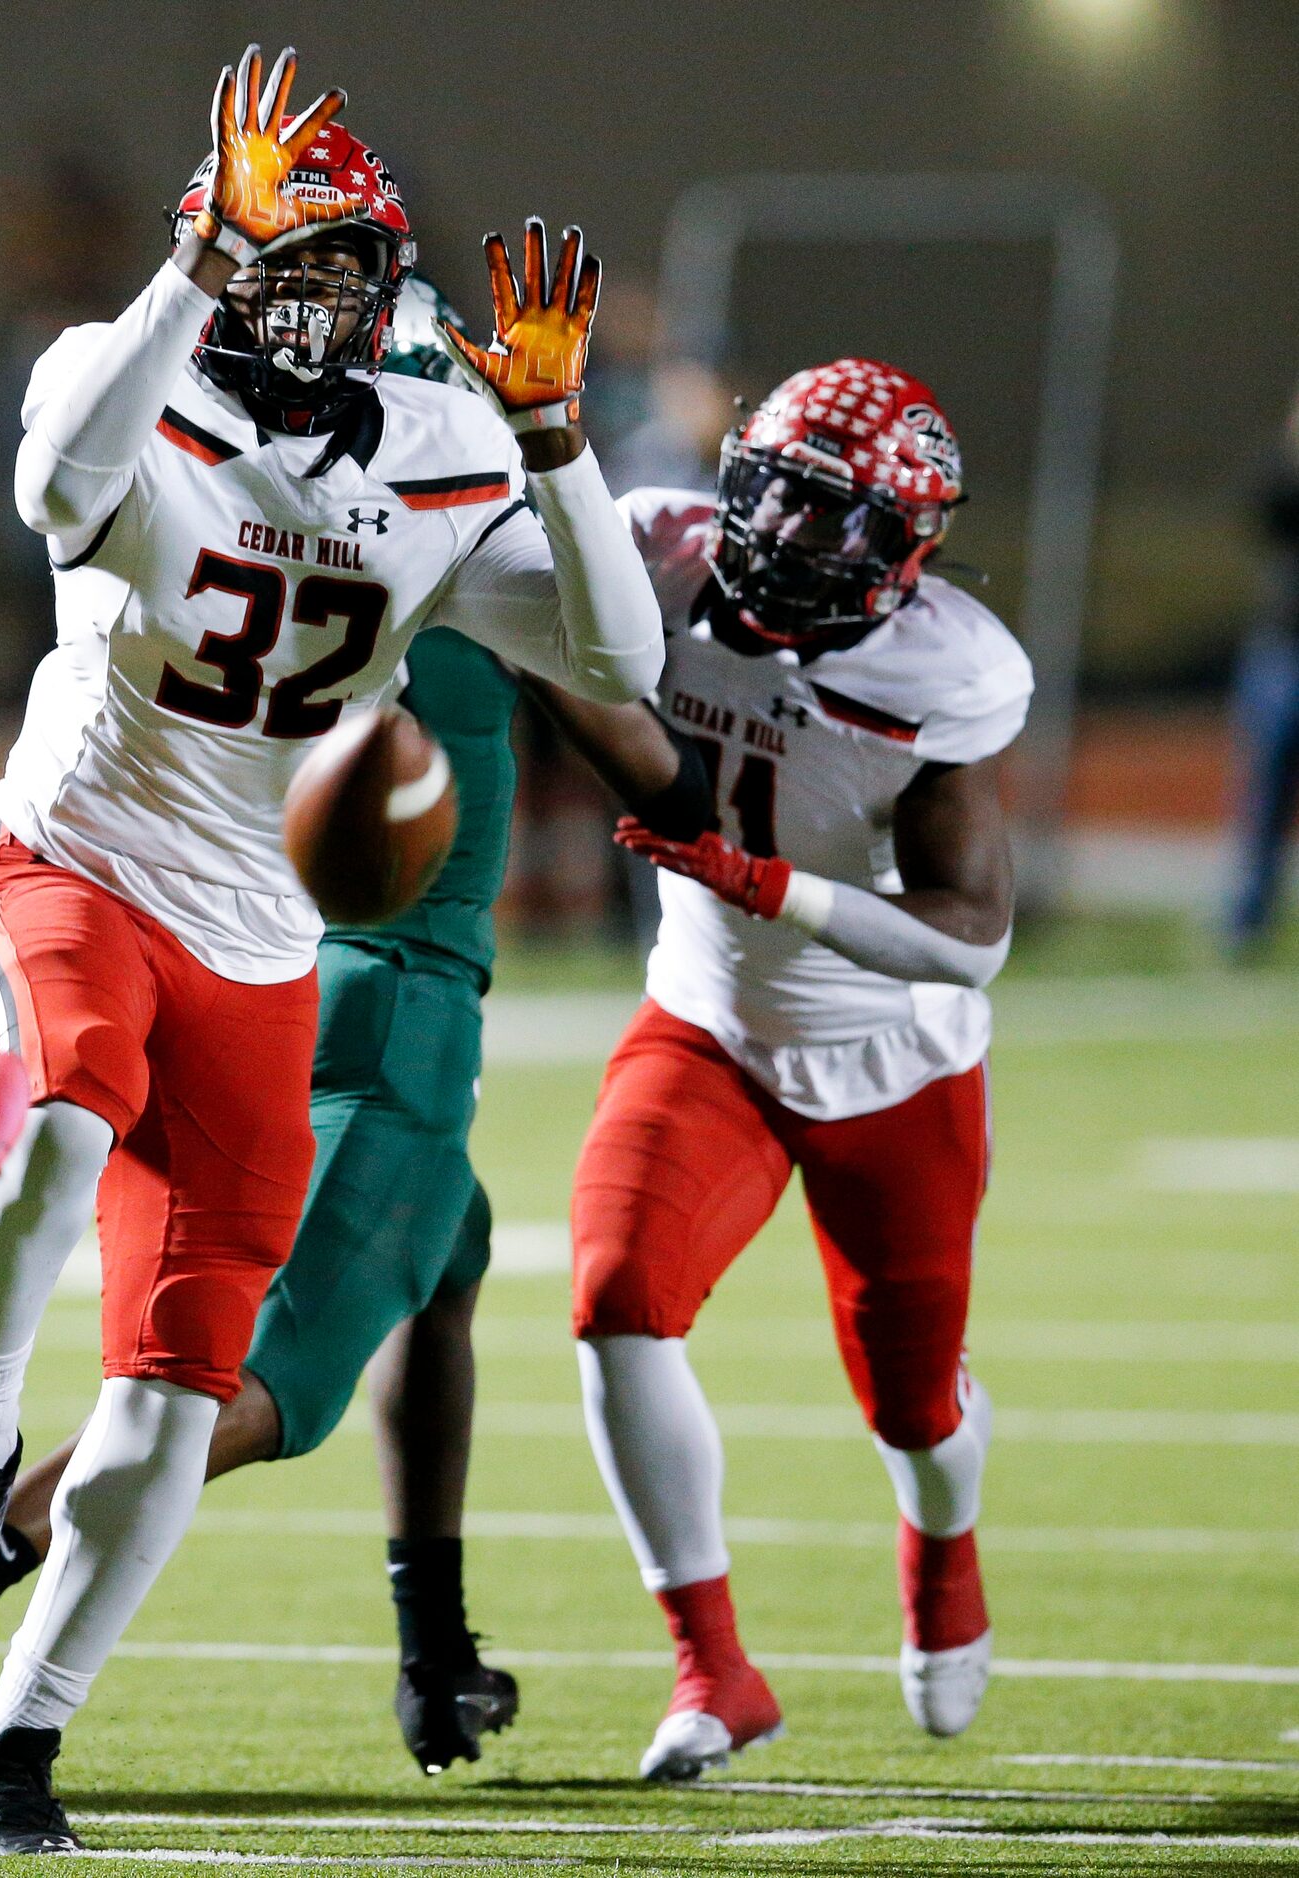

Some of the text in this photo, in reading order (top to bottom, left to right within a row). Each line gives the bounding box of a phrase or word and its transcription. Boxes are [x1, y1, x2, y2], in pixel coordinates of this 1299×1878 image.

[295, 186, 338, 201] ddell
[238, 520, 363, 571] CEDAR HILL
[155, 547, 388, 738] 32
[672, 691, 786, 757] CEDAR HILL
